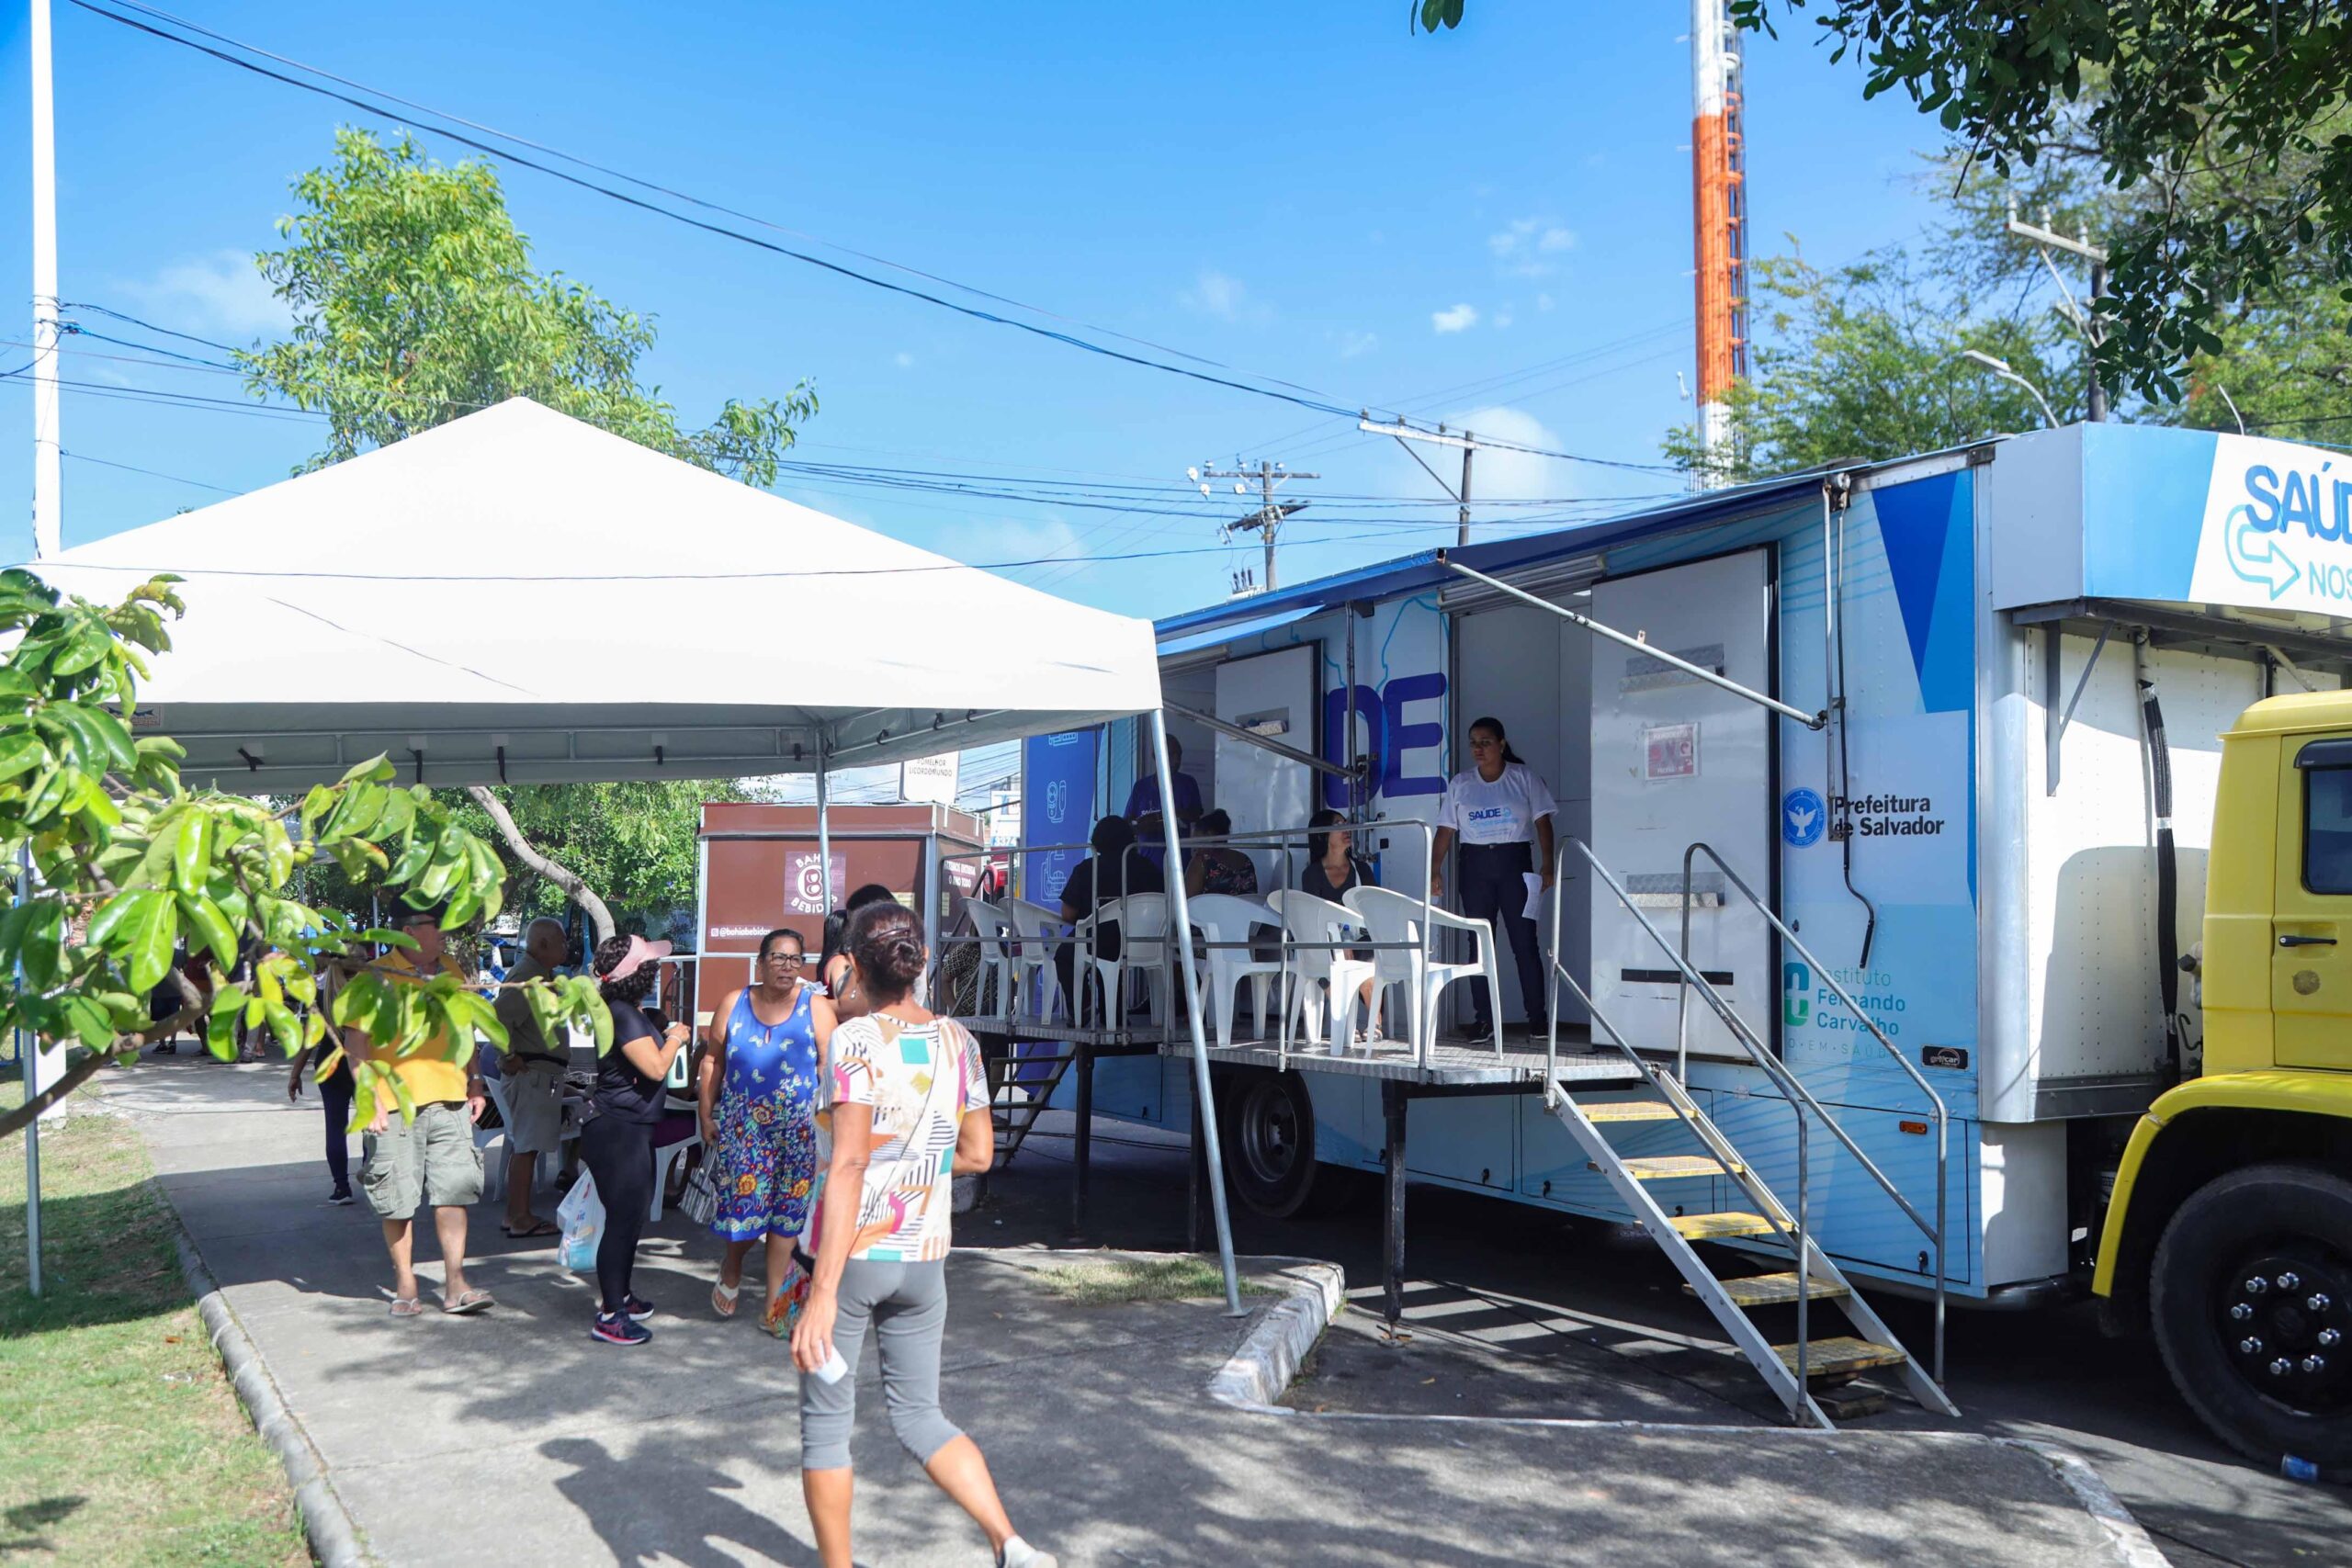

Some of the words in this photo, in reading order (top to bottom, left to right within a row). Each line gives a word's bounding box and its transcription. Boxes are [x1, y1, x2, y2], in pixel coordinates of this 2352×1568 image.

[1468, 807, 1501, 821] SAÚDE
[1835, 795, 1930, 815] Prefeitura
[1835, 818, 1854, 837] de
[1860, 816, 1945, 836] Salvador
[796, 853, 832, 868] BAH
[791, 895, 838, 913] BEBIDS
[1818, 967, 1891, 987] stituto
[1841, 1043, 1894, 1059] SAÚD
